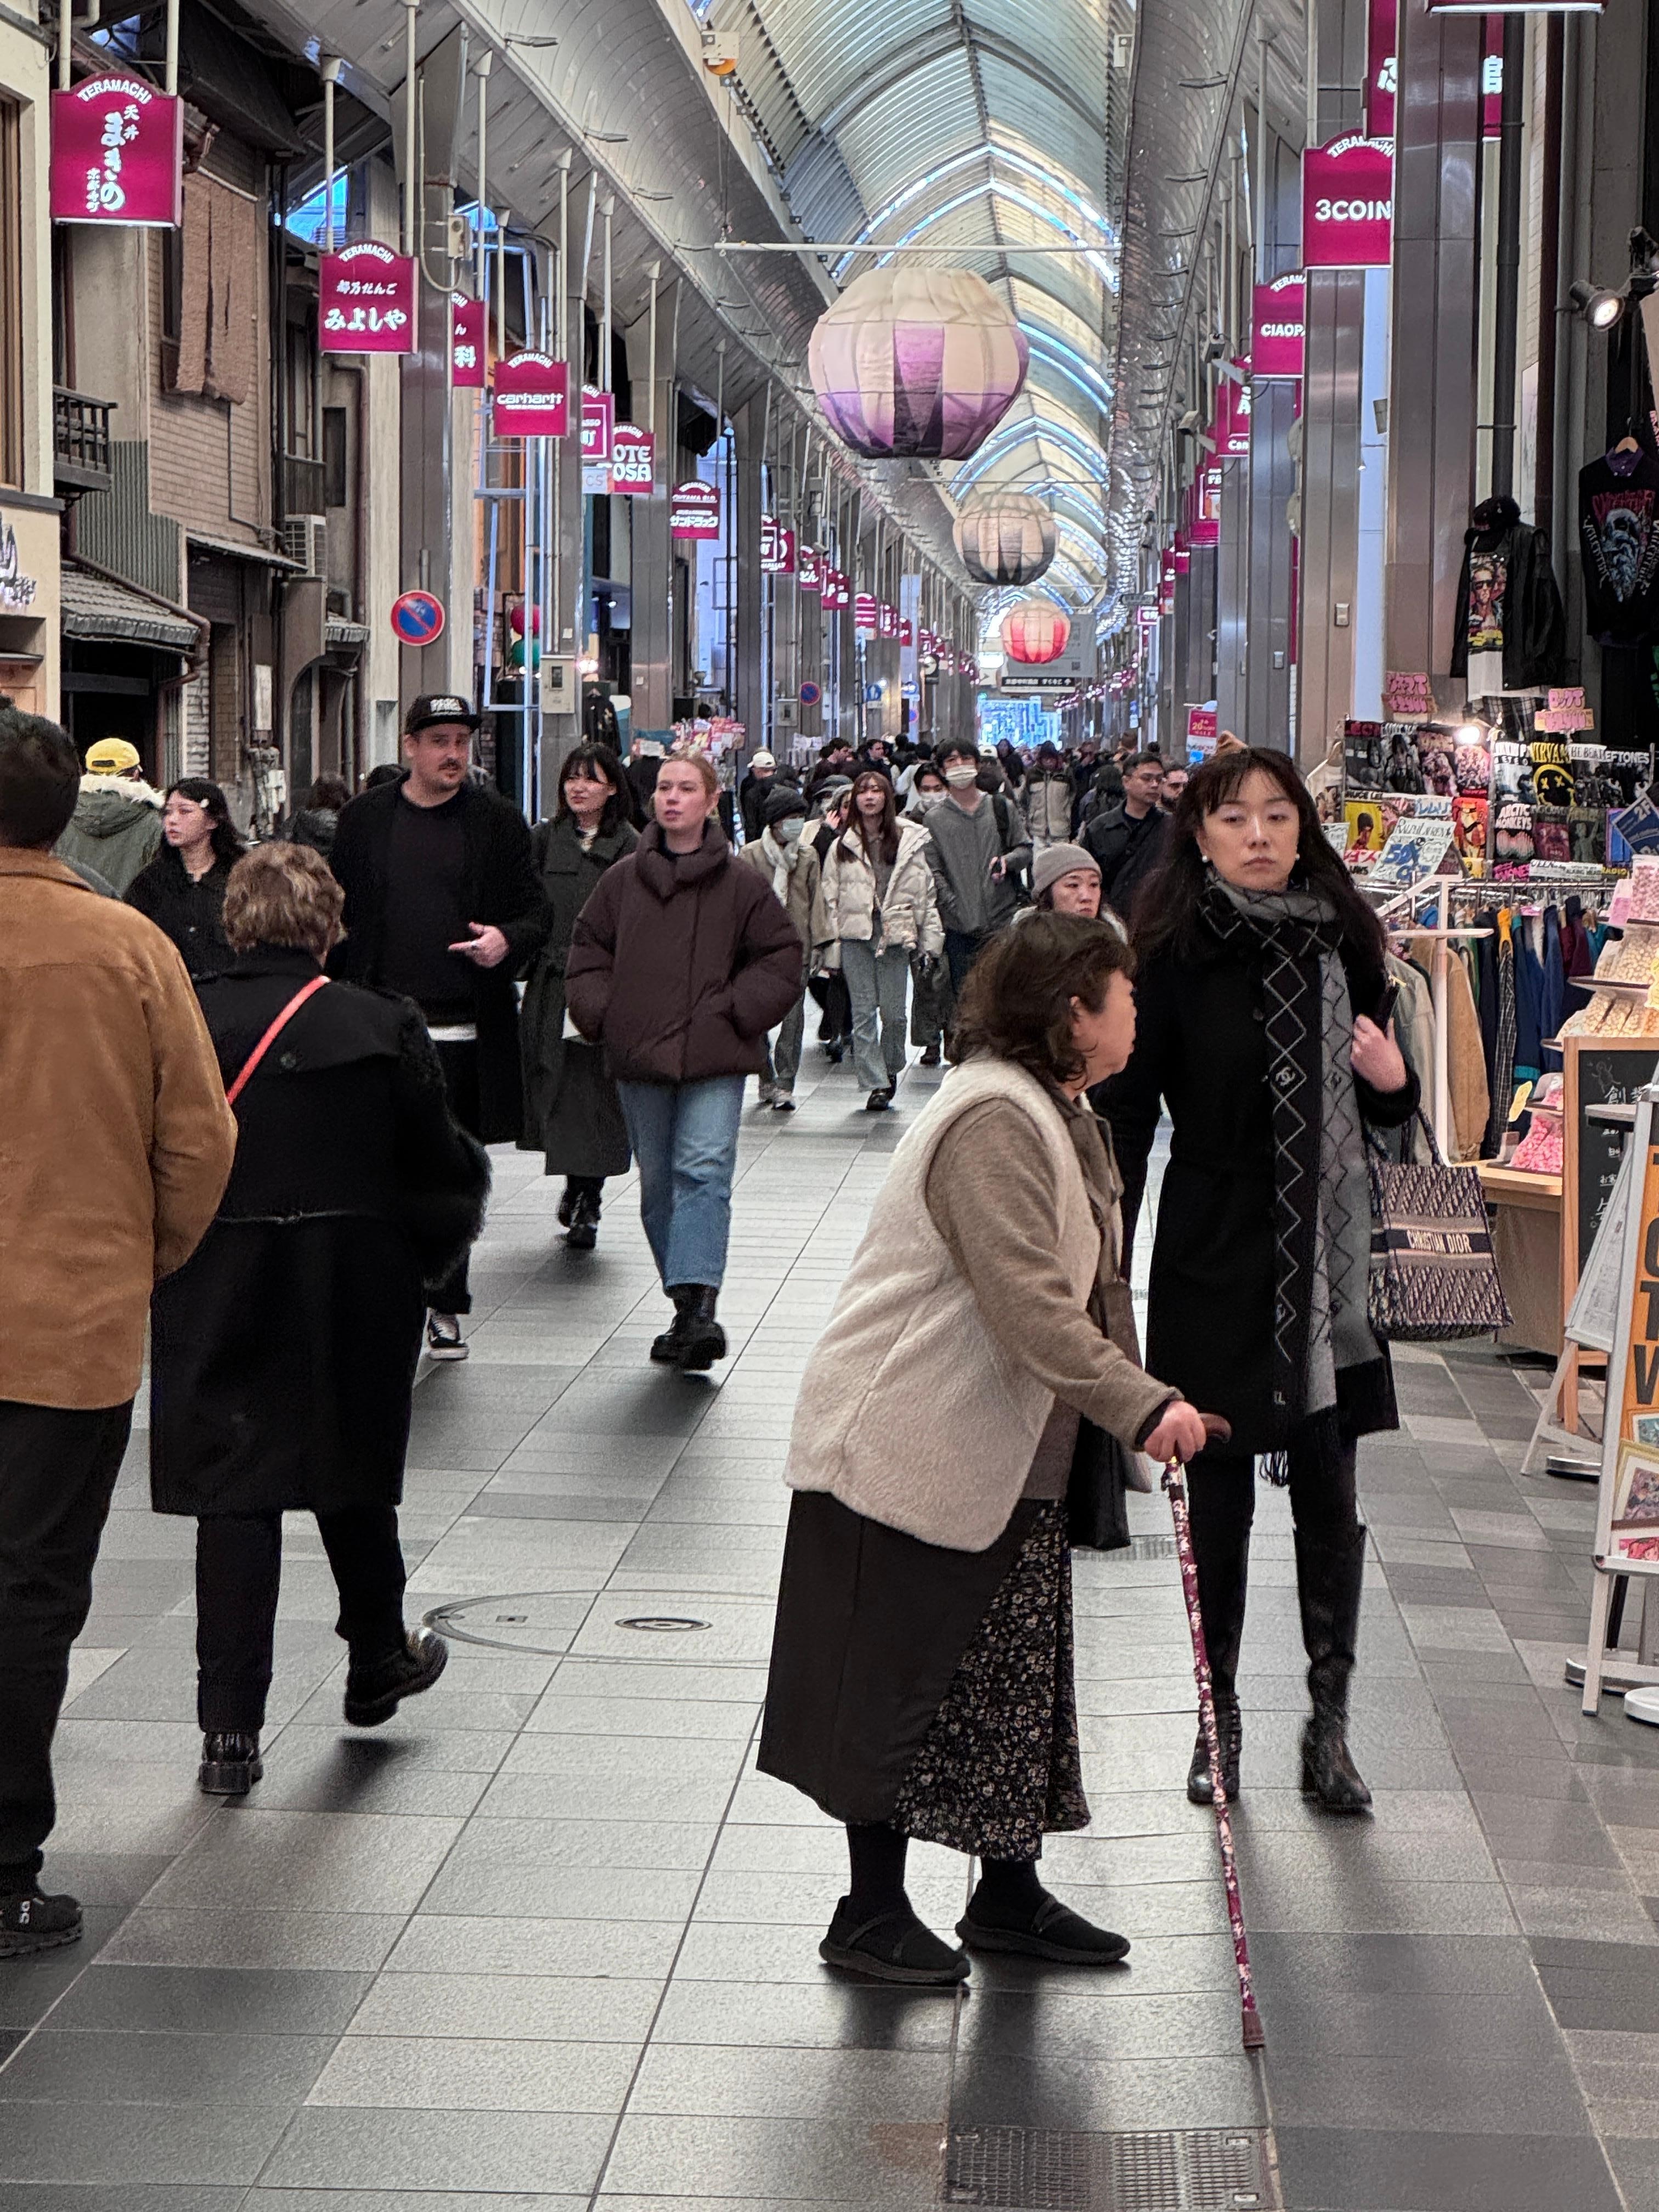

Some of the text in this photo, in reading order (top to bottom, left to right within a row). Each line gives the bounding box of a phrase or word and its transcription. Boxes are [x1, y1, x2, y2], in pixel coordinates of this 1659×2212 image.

[77, 79, 152, 104] TERAMACHI
[100, 111, 126, 212] まきの
[1315, 199, 1392, 222] 3COIN
[338, 244, 394, 264] TERAMACHI
[451, 292, 468, 308] CHI
[324, 307, 407, 332] みよしや
[507, 353, 554, 368] TERAMACHI
[497, 393, 563, 405] carhartt
[613, 444, 652, 463] OTE
[613, 462, 652, 482] OSA
[585, 475, 603, 487] CS
[670, 515, 719, 528] サンドラッグ
[1527, 742, 1572, 764] NIRVAN
[1571, 746, 1582, 758] HE
[1604, 750, 1650, 765] EFTONES
[1499, 804, 1531, 817] ARCTIC
[1494, 816, 1532, 830] MONKEYS
[1447, 1234, 1472, 1254] DIOR
